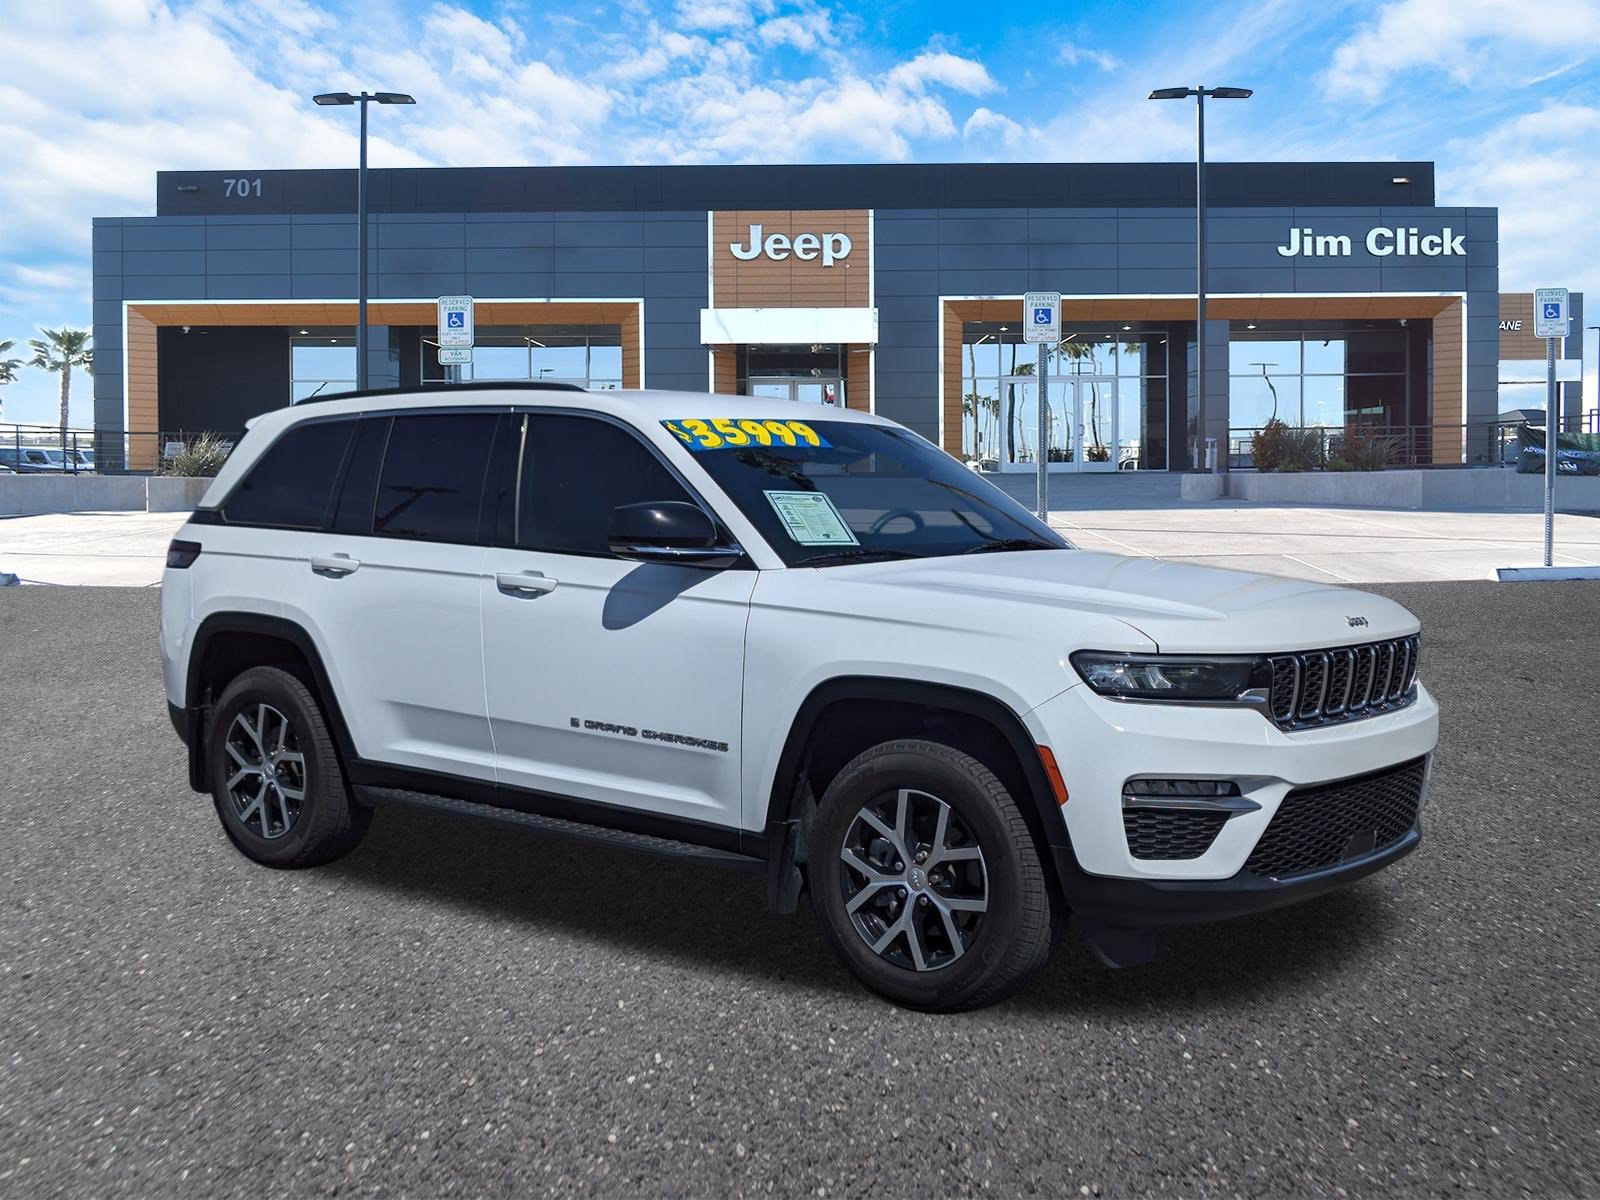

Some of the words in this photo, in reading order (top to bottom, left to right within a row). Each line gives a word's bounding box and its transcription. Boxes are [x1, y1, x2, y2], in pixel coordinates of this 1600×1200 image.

[223, 179, 262, 197] 701
[730, 224, 852, 267] Jeep
[1277, 227, 1352, 257] Jim
[1365, 227, 1467, 257] Click
[665, 418, 821, 448] $35999
[584, 719, 638, 737] GRAND
[641, 729, 729, 753] CHEROKEE
